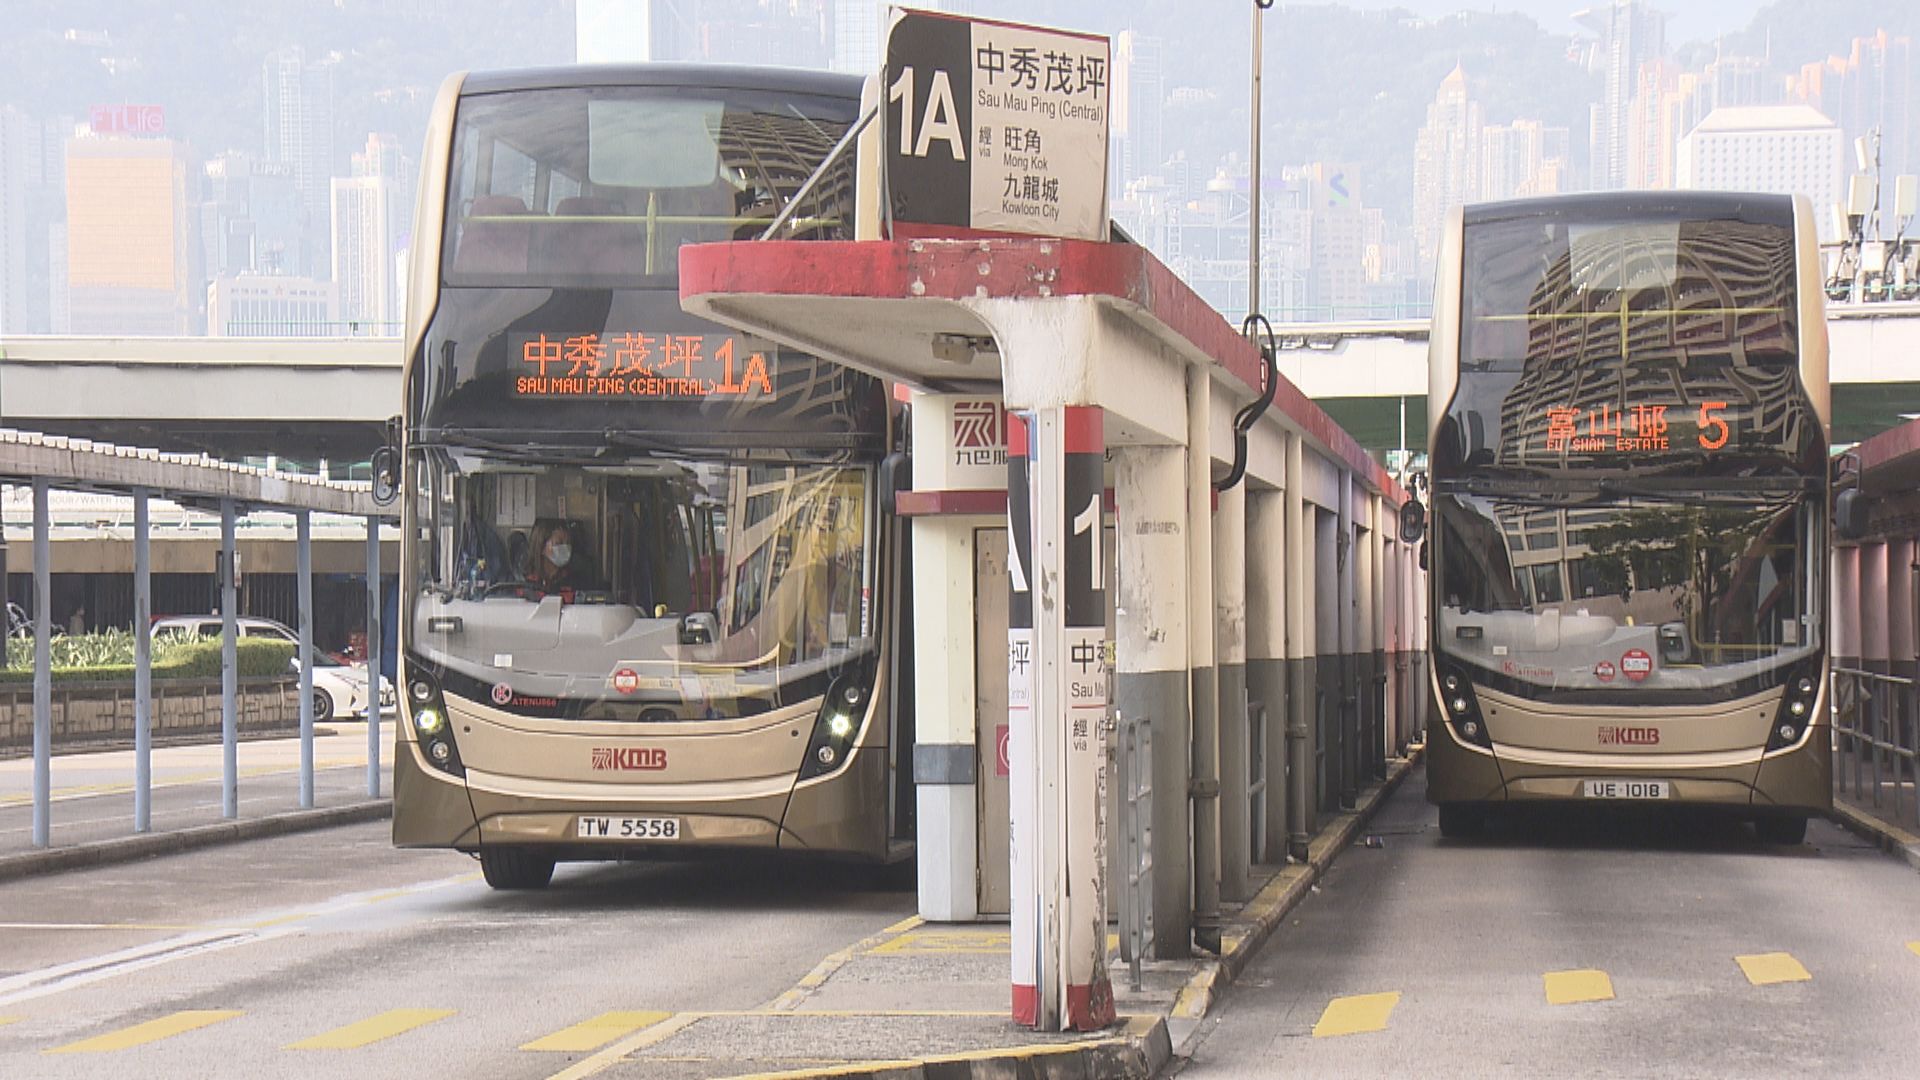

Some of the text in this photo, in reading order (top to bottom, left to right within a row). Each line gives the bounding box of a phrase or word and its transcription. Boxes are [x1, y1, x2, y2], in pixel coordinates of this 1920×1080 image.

[976, 42, 1105, 100] 中秀茂坪
[890, 65, 966, 162] 1A
[978, 89, 1104, 125] Sau Mau Ping (Central)
[979, 126, 1041, 154] 經 旺角
[979, 146, 991, 157] via
[1003, 152, 1048, 171] Mong Kok
[252, 161, 290, 176] LIPPO
[1003, 172, 1059, 203] 九龍城
[1002, 200, 1059, 222] Kowloon City
[523, 332, 703, 377] 中秀茂坪
[714, 338, 773, 394] 1A
[517, 377, 715, 395] SAU MAU PING (CENTRAL)
[1547, 404, 1668, 439] 富山邨
[1698, 402, 1729, 450] 5
[1546, 438, 1563, 451] FU
[1616, 437, 1669, 451] ESTATE
[1074, 494, 1105, 590] 1
[1071, 682, 1093, 697] Sau
[1073, 719, 1088, 737] 經
[1615, 727, 1660, 744] KMB
[1073, 740, 1087, 751] via
[613, 748, 668, 771] KMB
[1593, 783, 1660, 797] UE 1018
[583, 818, 676, 837] TW 5558
